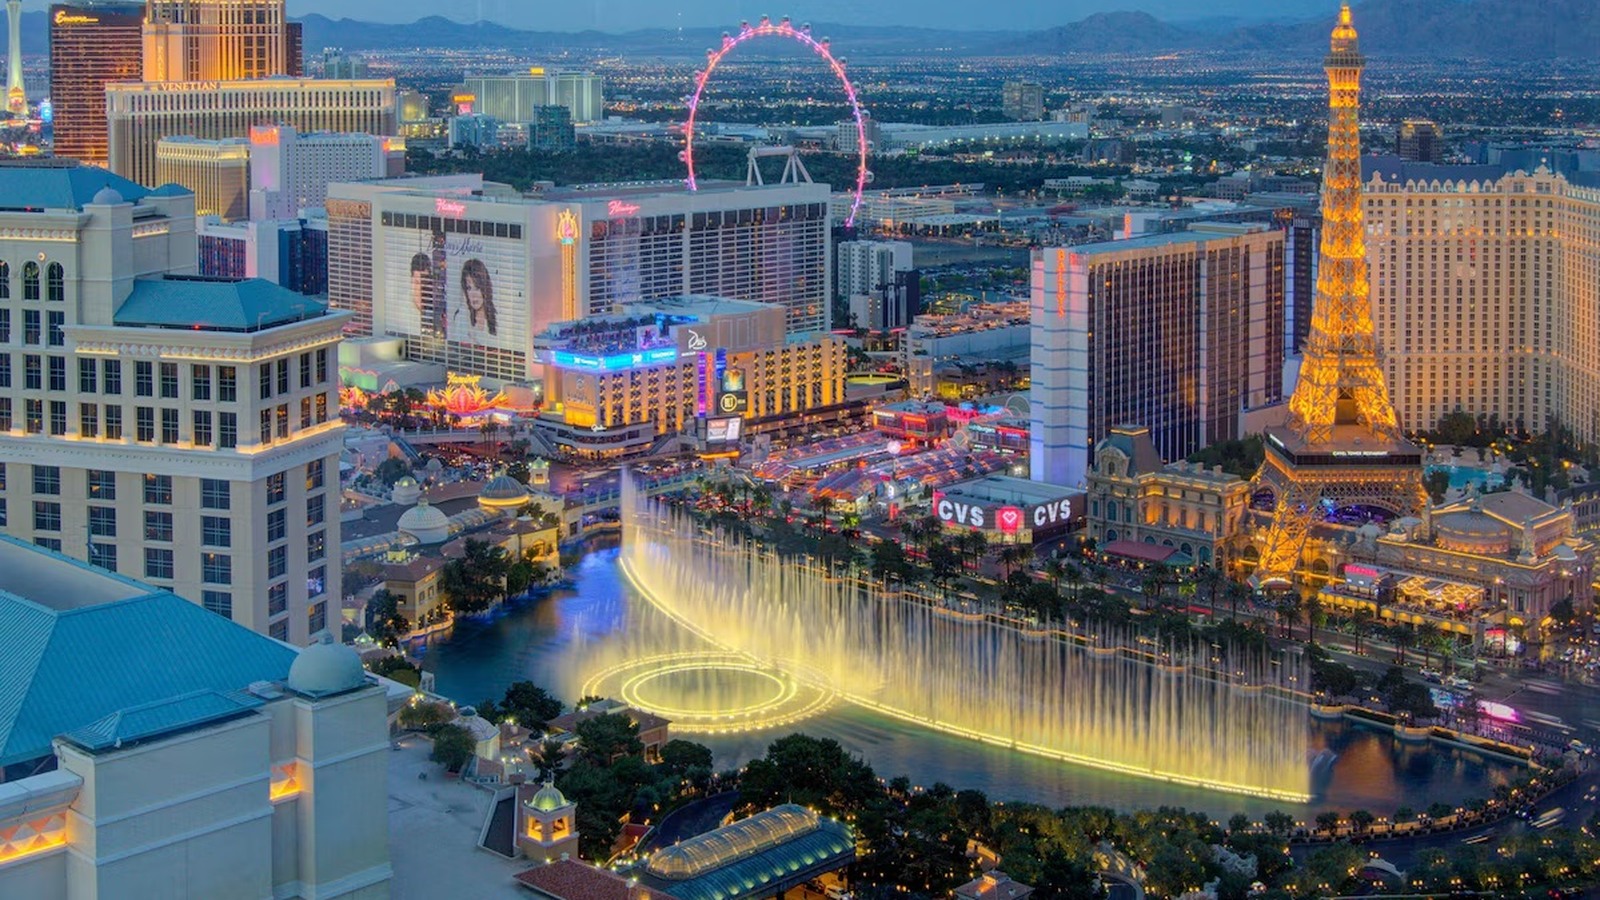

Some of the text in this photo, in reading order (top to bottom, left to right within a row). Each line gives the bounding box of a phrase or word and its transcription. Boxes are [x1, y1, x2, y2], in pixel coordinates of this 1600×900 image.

[160, 82, 217, 91] VENETIAN
[607, 199, 640, 216] Flamingo
[938, 500, 984, 527] CVS
[1034, 499, 1071, 526] CVS
